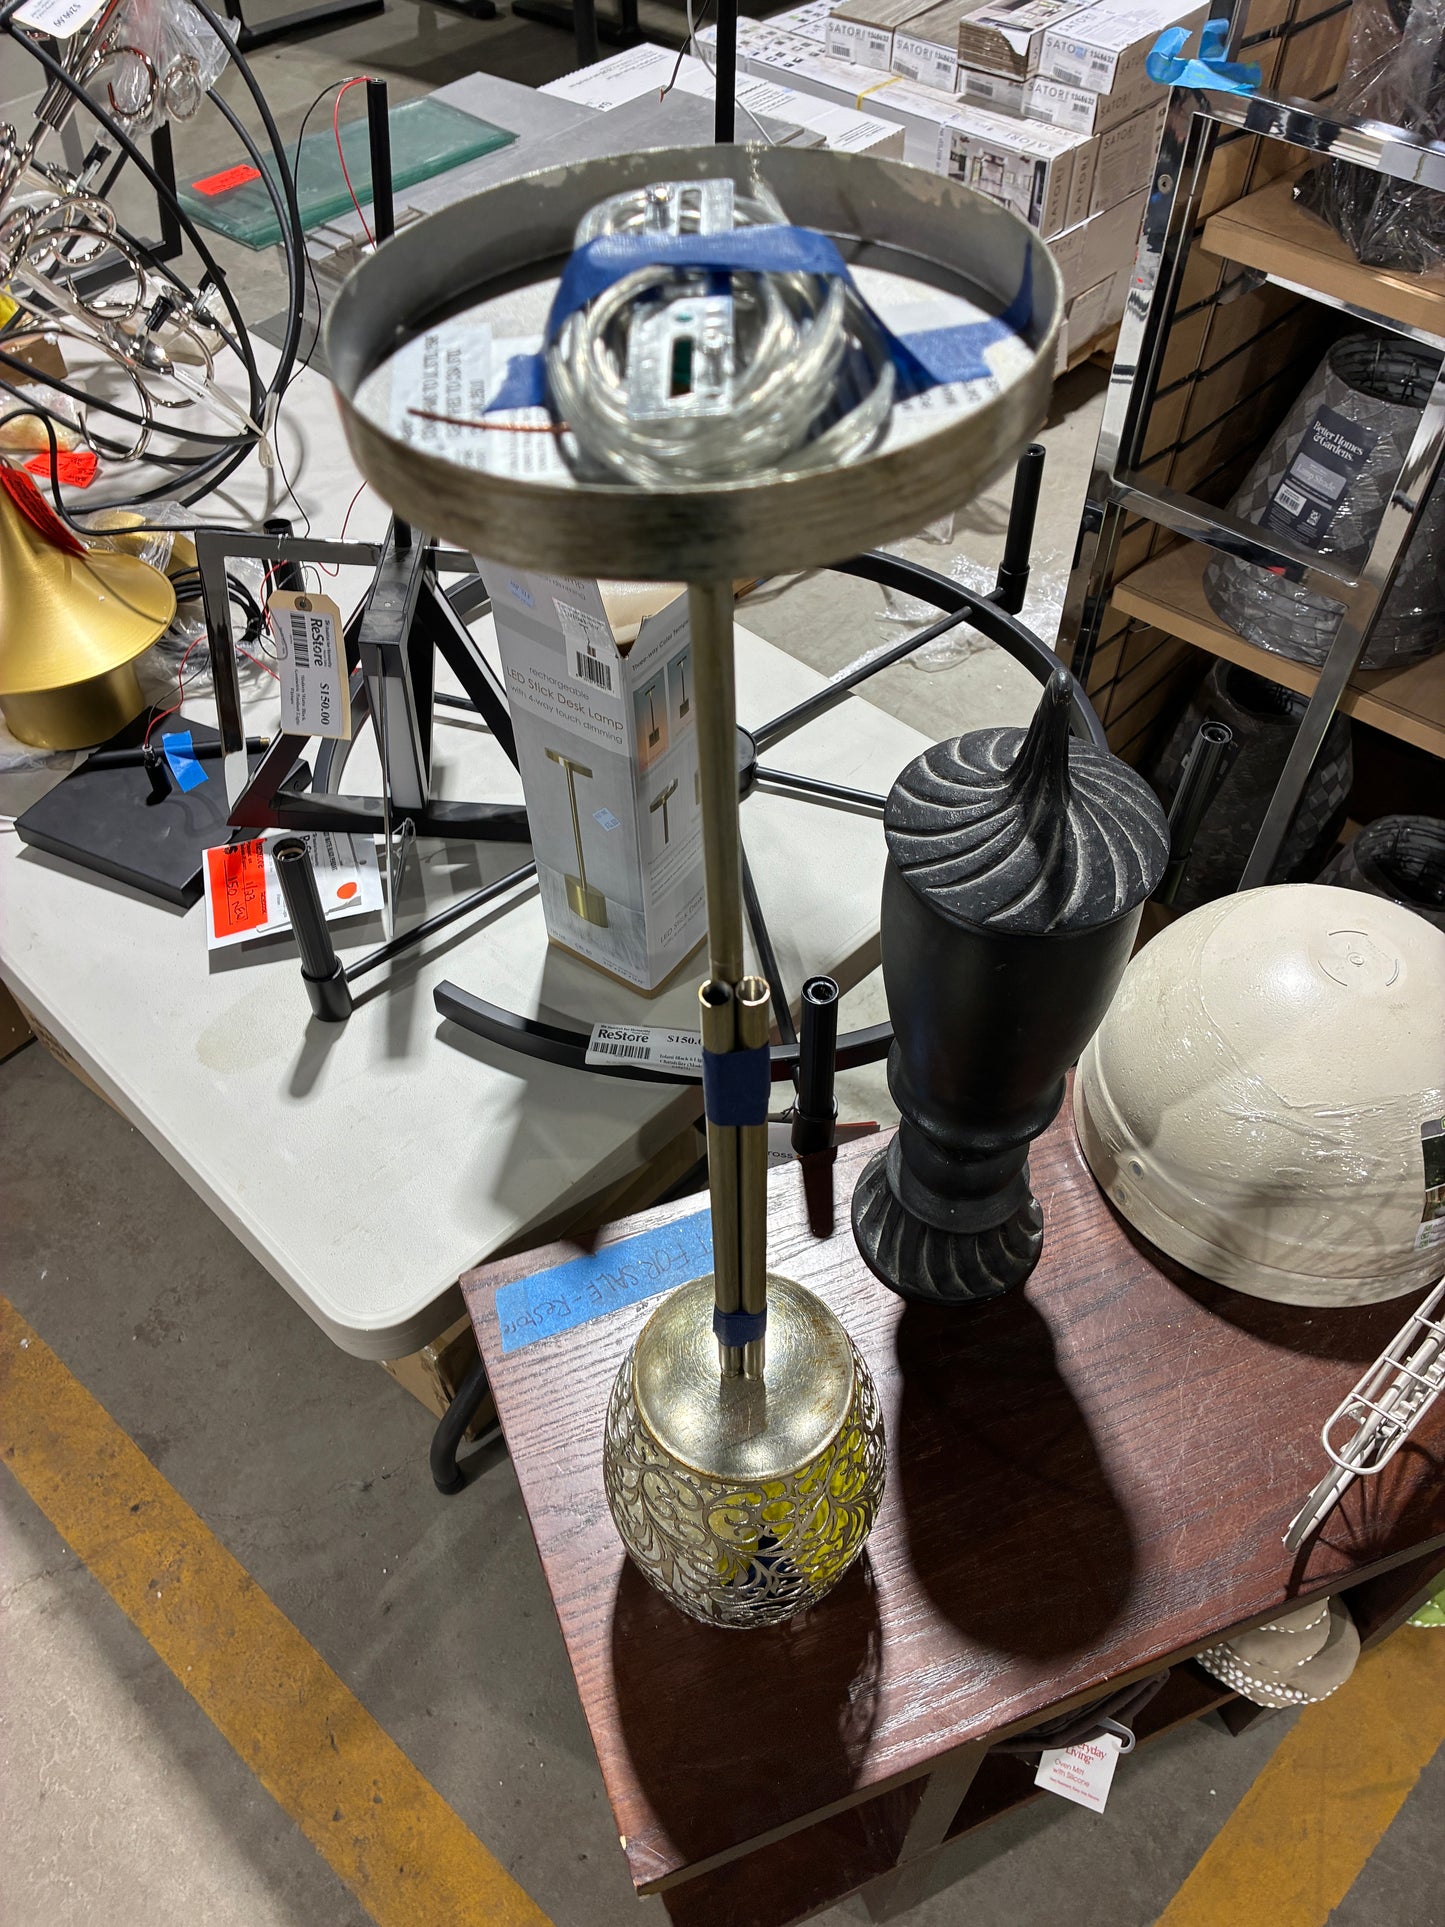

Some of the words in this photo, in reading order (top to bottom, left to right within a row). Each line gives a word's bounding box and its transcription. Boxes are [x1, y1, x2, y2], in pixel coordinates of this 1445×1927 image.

[828, 22, 866, 39] SATORI
[1045, 36, 1089, 59] SATORI
[896, 39, 934, 59] SATORI
[1027, 81, 1069, 100] SATORI
[1103, 123, 1137, 150] SATORI
[1313, 420, 1335, 441] Better
[1333, 434, 1364, 456] Homes
[310, 618, 324, 667] ReStore
[506, 665, 526, 685] LED
[528, 678, 555, 700] Stick
[557, 692, 586, 714] Desk
[588, 707, 624, 731] Lamp
[529, 667, 590, 701] rechargeable
[320, 682, 330, 725] $150.00
[555, 707, 582, 726] touch
[583, 721, 623, 745] dimming
[598, 1029, 649, 1043] ReStore
[644, 1239, 690, 1281] FOR
[587, 1263, 639, 1306] SALE
